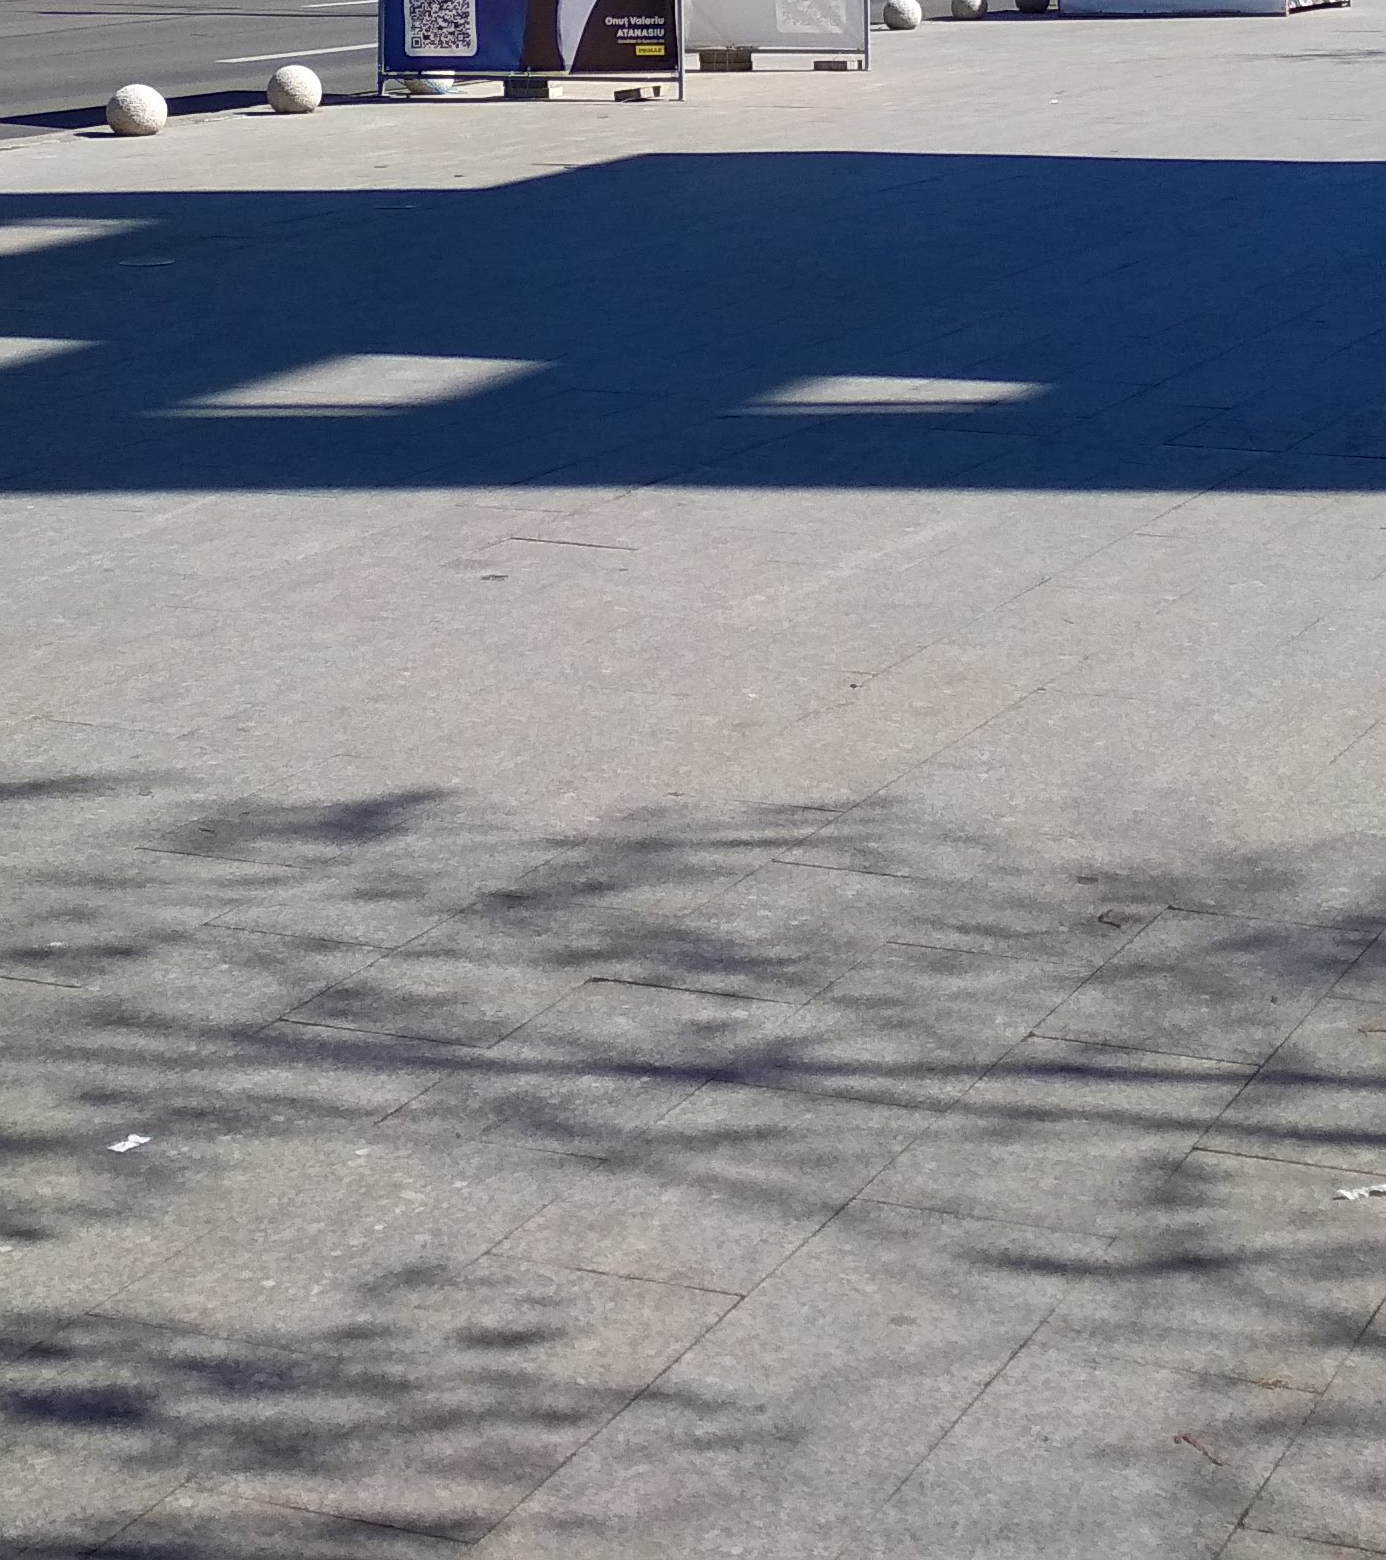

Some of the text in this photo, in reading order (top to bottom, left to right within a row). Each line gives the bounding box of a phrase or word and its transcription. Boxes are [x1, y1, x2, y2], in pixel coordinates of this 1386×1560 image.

[605, 16, 665, 27] Onuț Valeriu
[616, 28, 665, 37] ATANASIU
